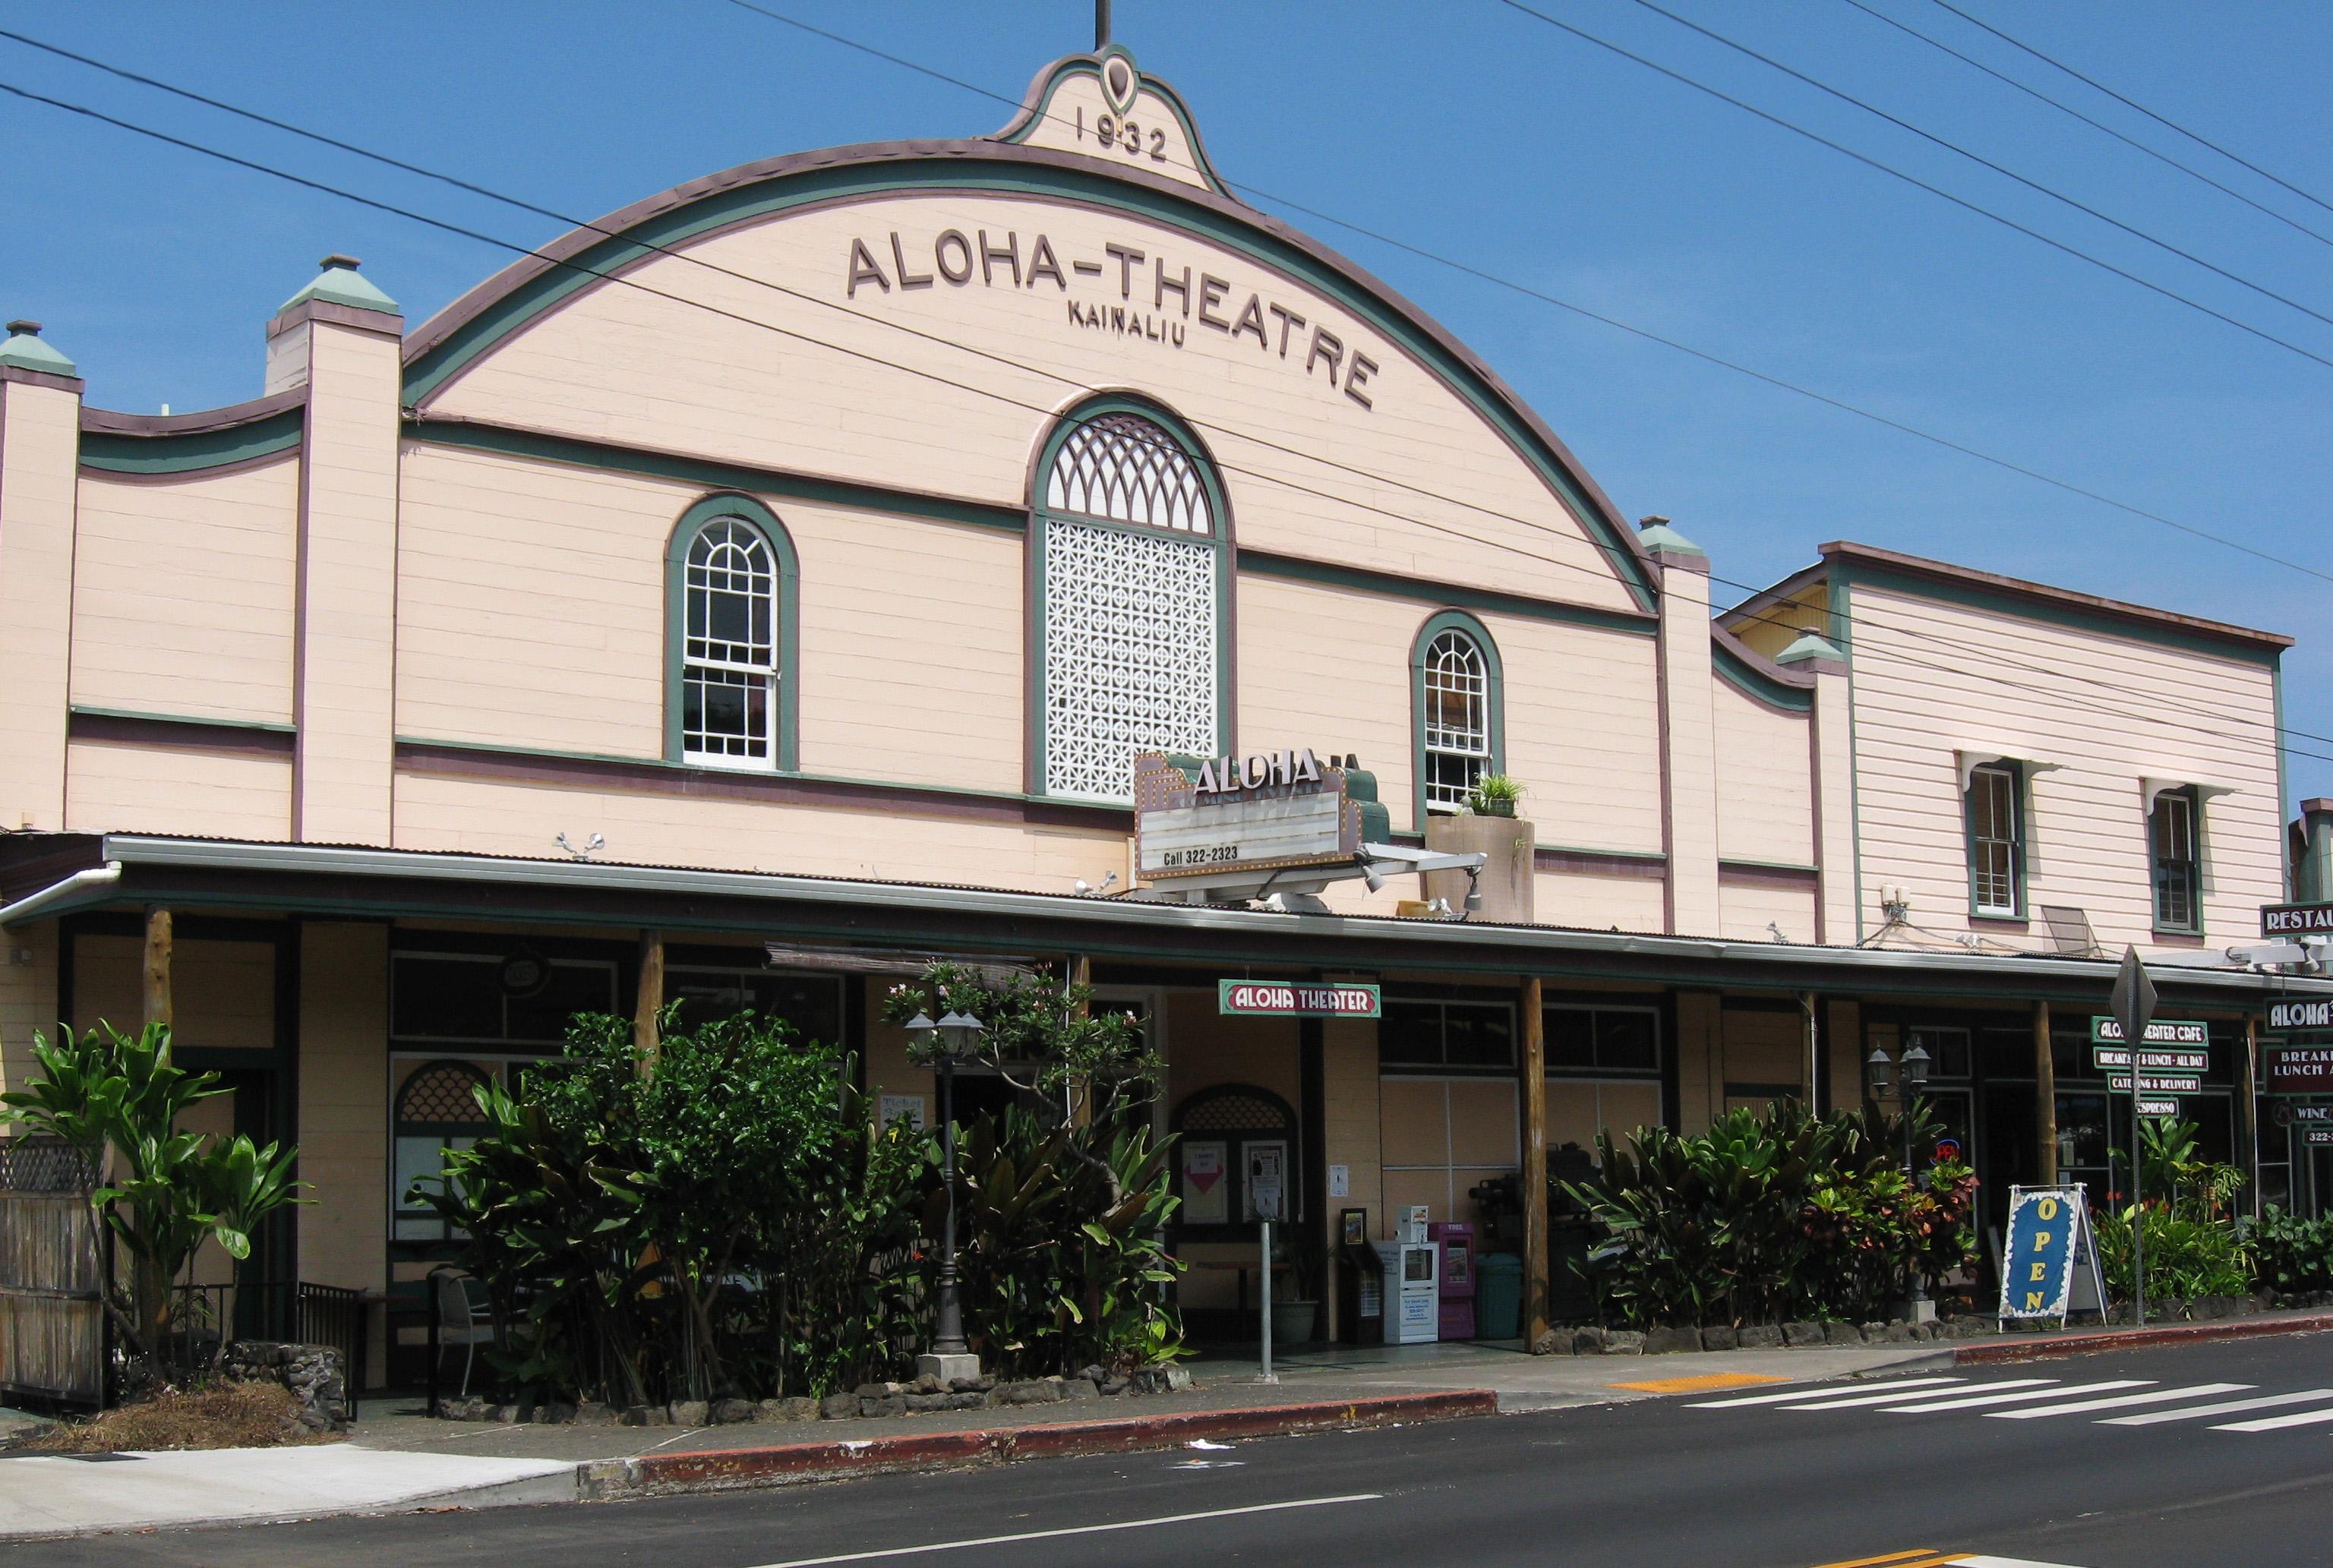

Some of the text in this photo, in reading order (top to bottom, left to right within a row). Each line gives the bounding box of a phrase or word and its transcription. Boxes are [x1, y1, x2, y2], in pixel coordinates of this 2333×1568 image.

[1076, 106, 1166, 164] 1932
[1067, 299, 1186, 349] KAINALIU
[1193, 746, 1323, 797] ALOHA
[1163, 846, 1238, 866] Call 322-2323
[1235, 987, 1369, 1011] ALOHA THEATER
[2271, 1002, 2329, 1026] ALOHA
[2142, 1025, 2175, 1040] EATER
[2177, 1026, 2202, 1041] CAFE
[2142, 1054, 2147, 1065] &
[2148, 1054, 2172, 1065] LUNCH
[2177, 1055, 2189, 1066] ALL
[2189, 1055, 2203, 1067] DAY
[2281, 1050, 2333, 1062] BREAK
[2275, 1065, 2323, 1076] LUNCH
[2152, 1079, 2158, 1089] &
[2160, 1079, 2197, 1090] DELIVERY
[2298, 1108, 2328, 1118] WINE
[2025, 1197, 2058, 1311] OPEN
